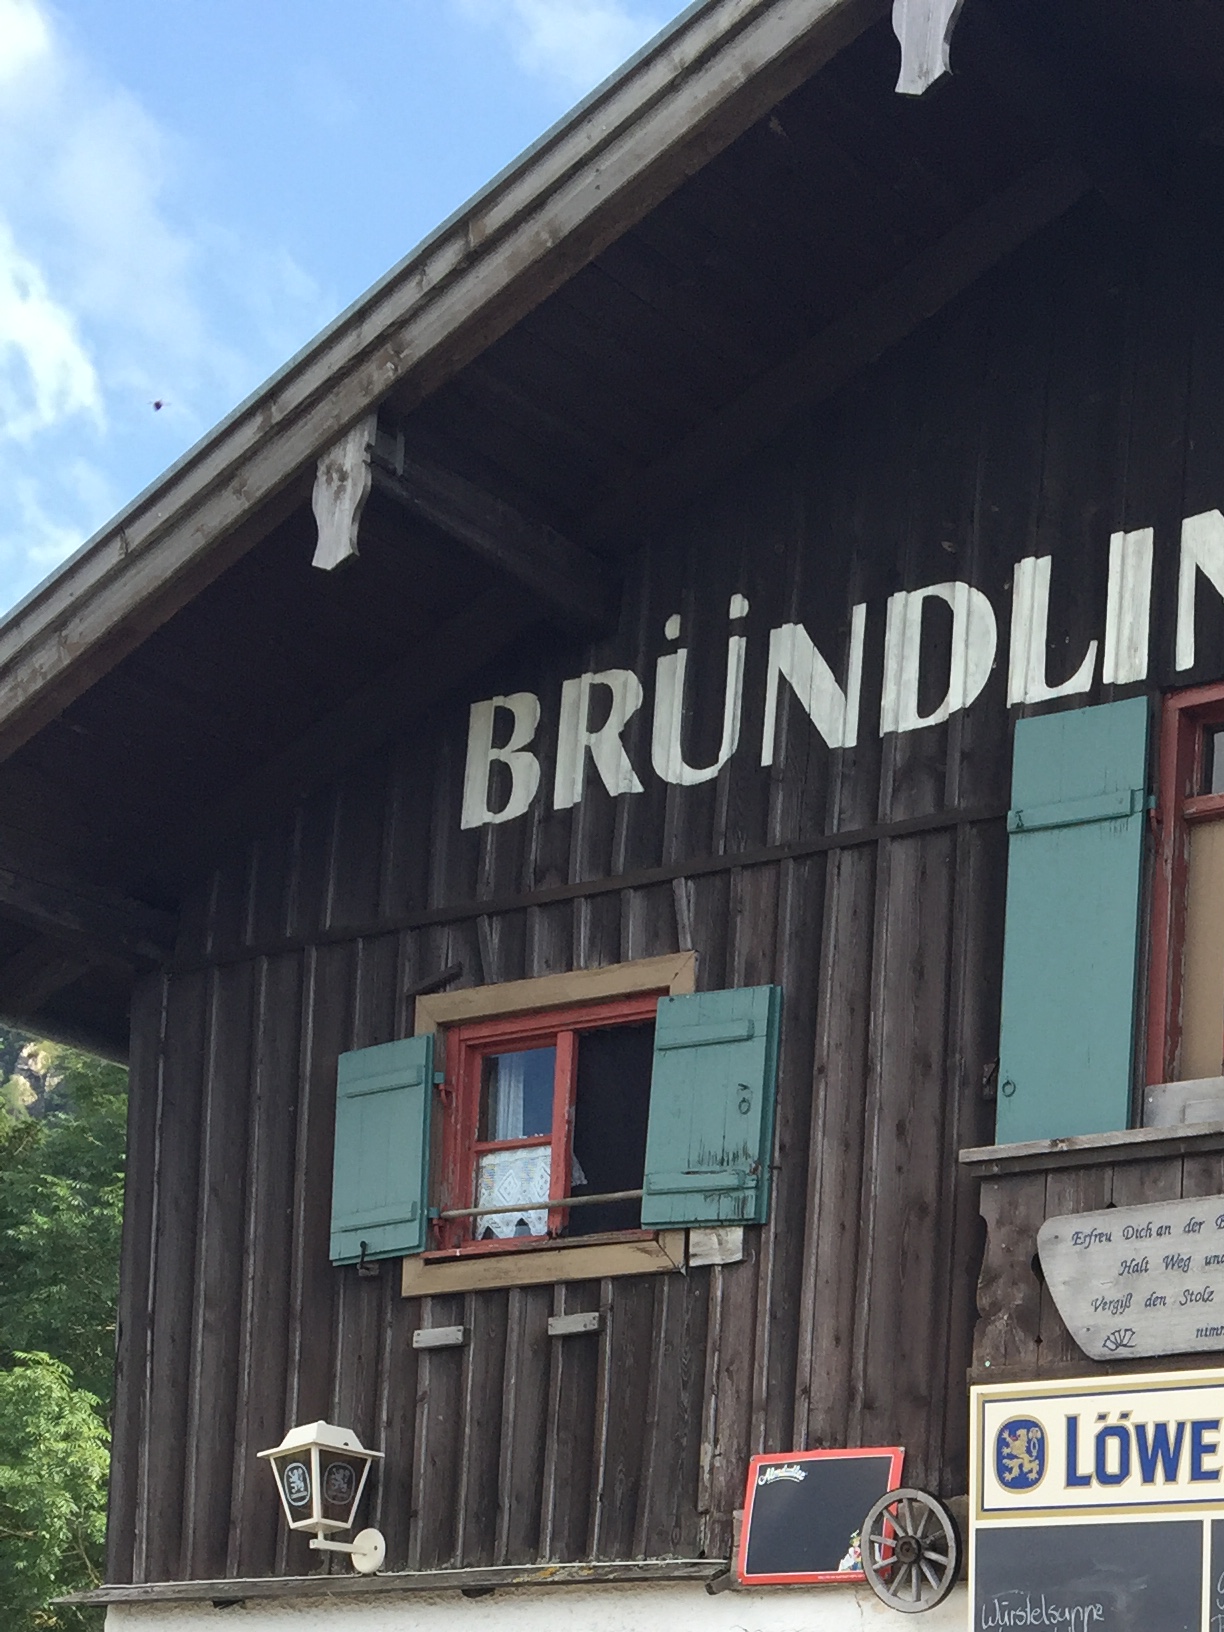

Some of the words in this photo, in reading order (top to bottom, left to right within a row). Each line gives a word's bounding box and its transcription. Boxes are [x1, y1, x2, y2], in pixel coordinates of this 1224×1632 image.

[1072, 1229, 1112, 1249] Erfreu
[1123, 1222, 1153, 1241] Dich
[1156, 1224, 1172, 1236] an
[1183, 1216, 1205, 1234] der
[1119, 1256, 1149, 1277] Halt
[1163, 1254, 1191, 1272] Weg
[1092, 1293, 1133, 1314] Vergiß
[1145, 1291, 1167, 1307] den
[1179, 1287, 1214, 1305] Stolz
[981, 1594, 1105, 1632] Würstelsuppe
